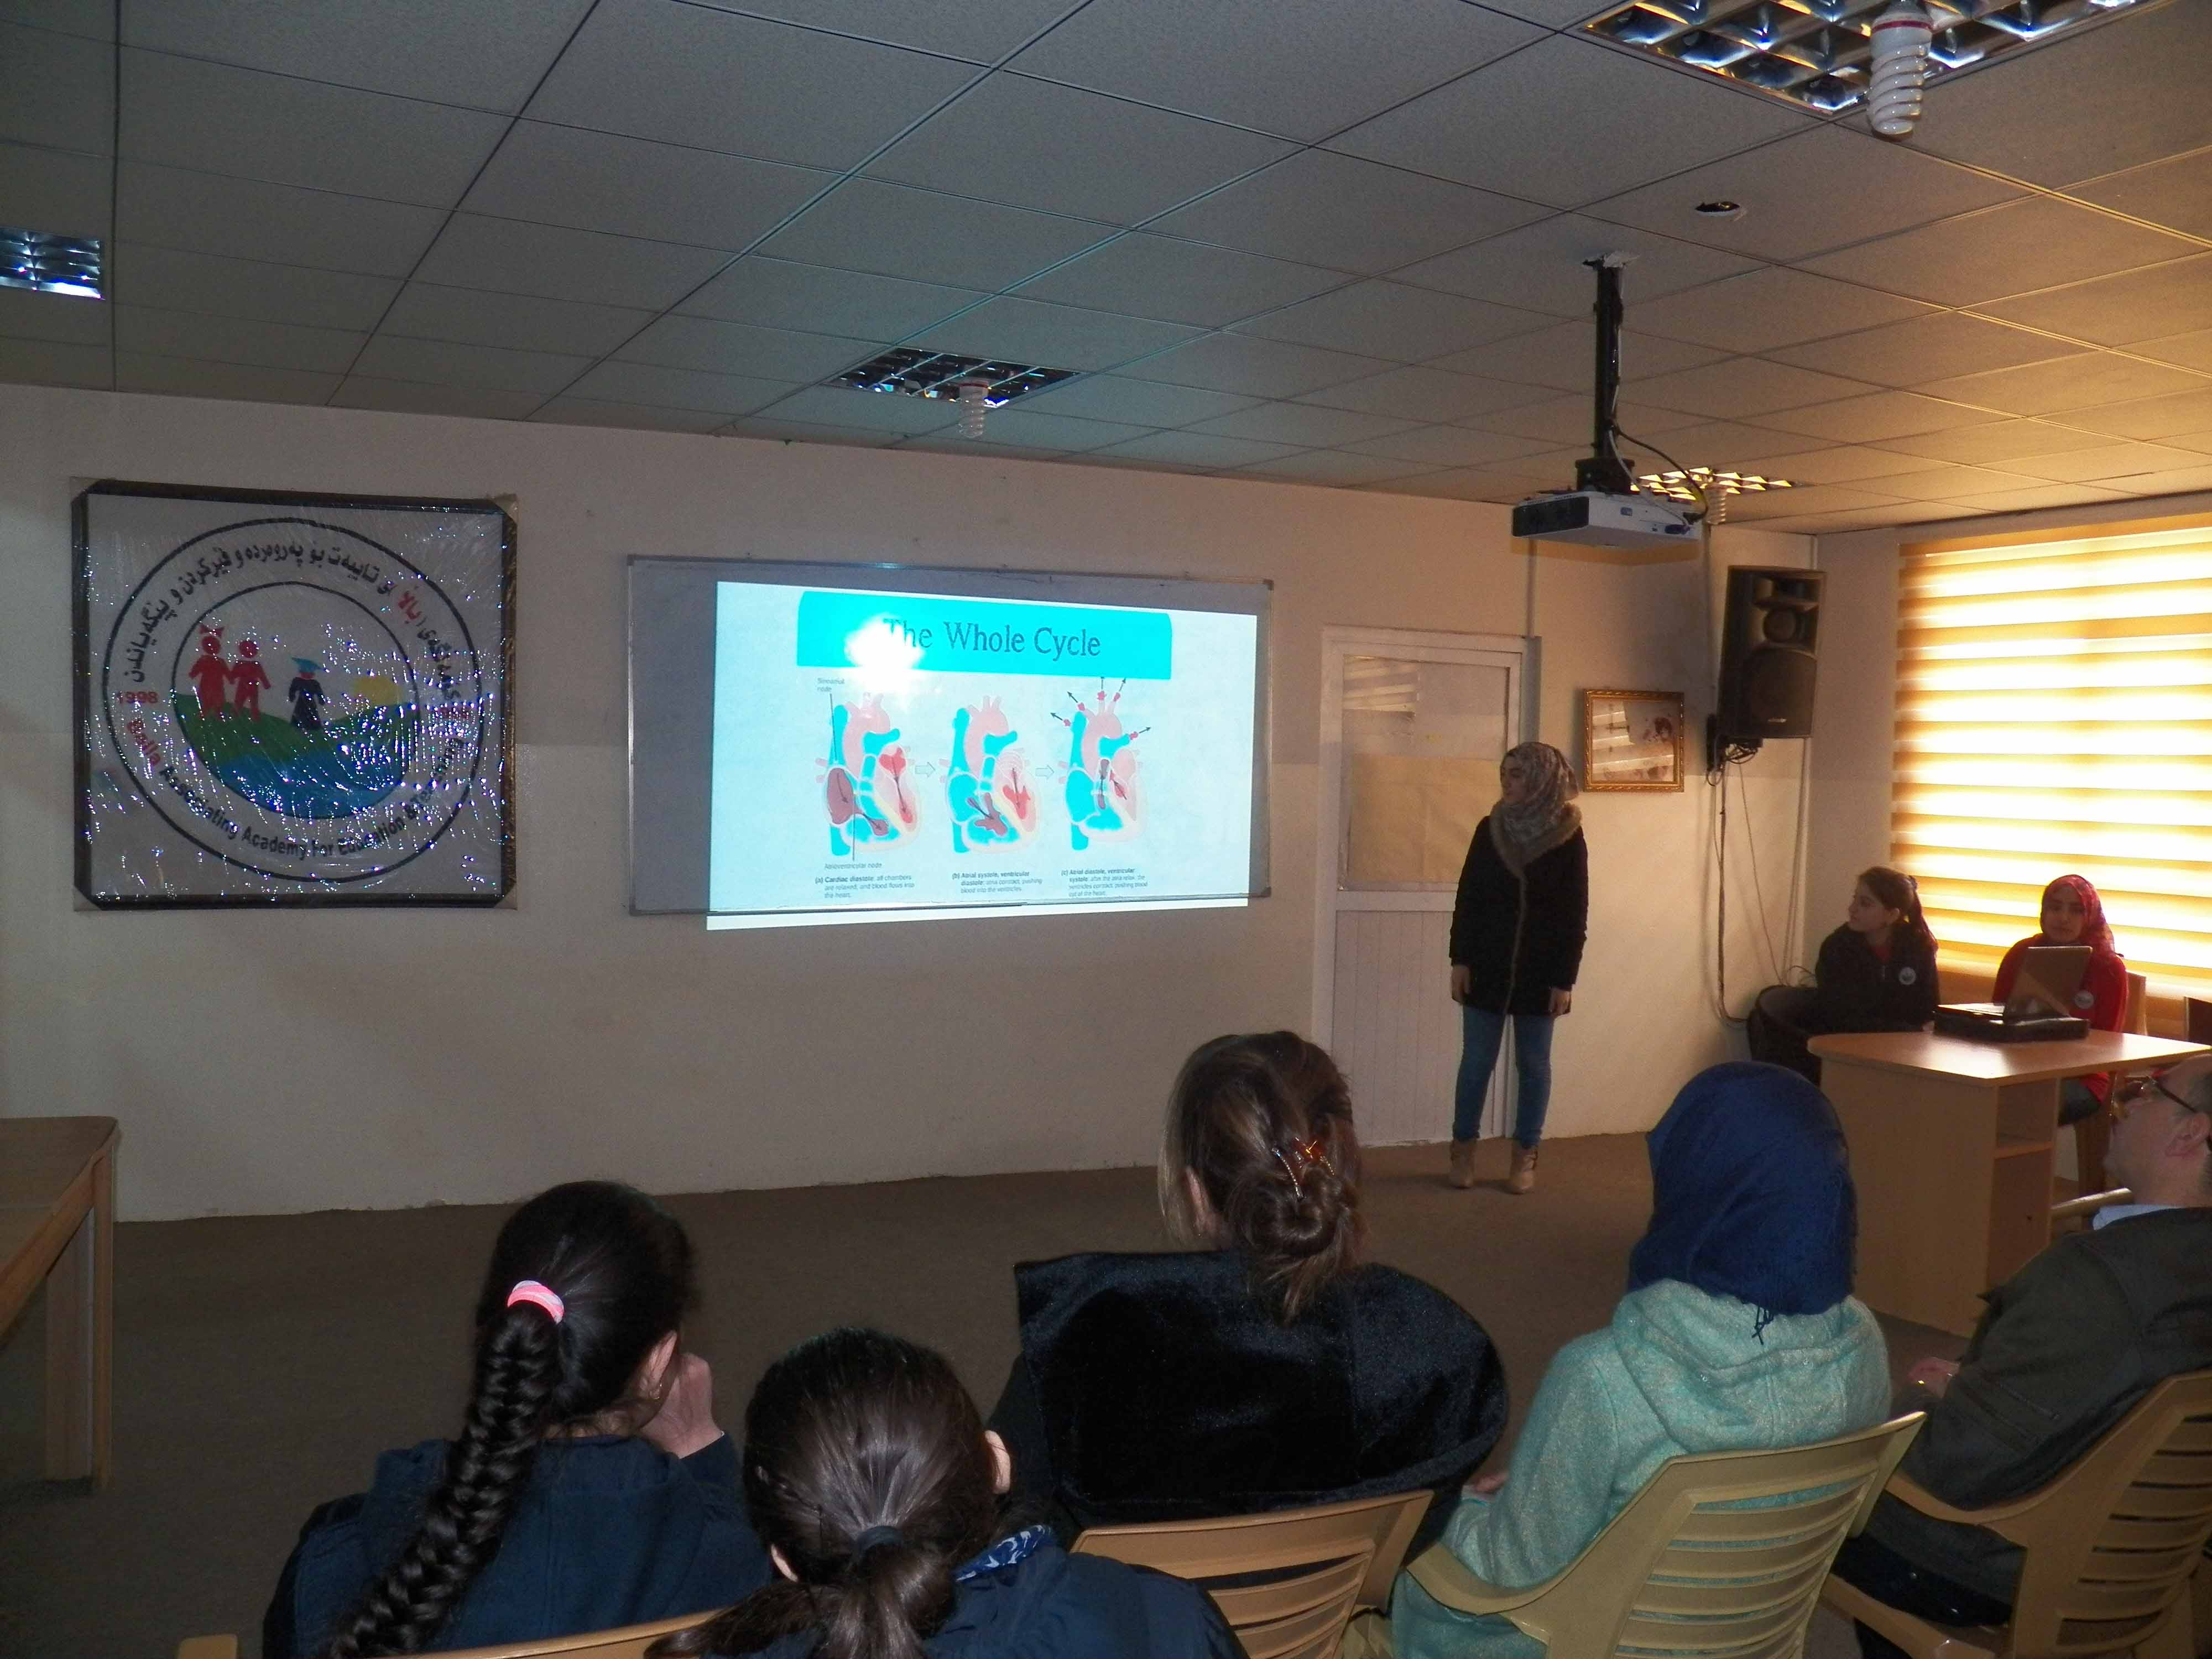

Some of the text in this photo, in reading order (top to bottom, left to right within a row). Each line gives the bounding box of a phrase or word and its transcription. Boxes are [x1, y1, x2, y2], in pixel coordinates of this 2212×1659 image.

[883, 618, 1101, 661] The Whole Cycle
[117, 691, 158, 703] 1998
[242, 826, 305, 860] Academy
[312, 839, 333, 857] For
